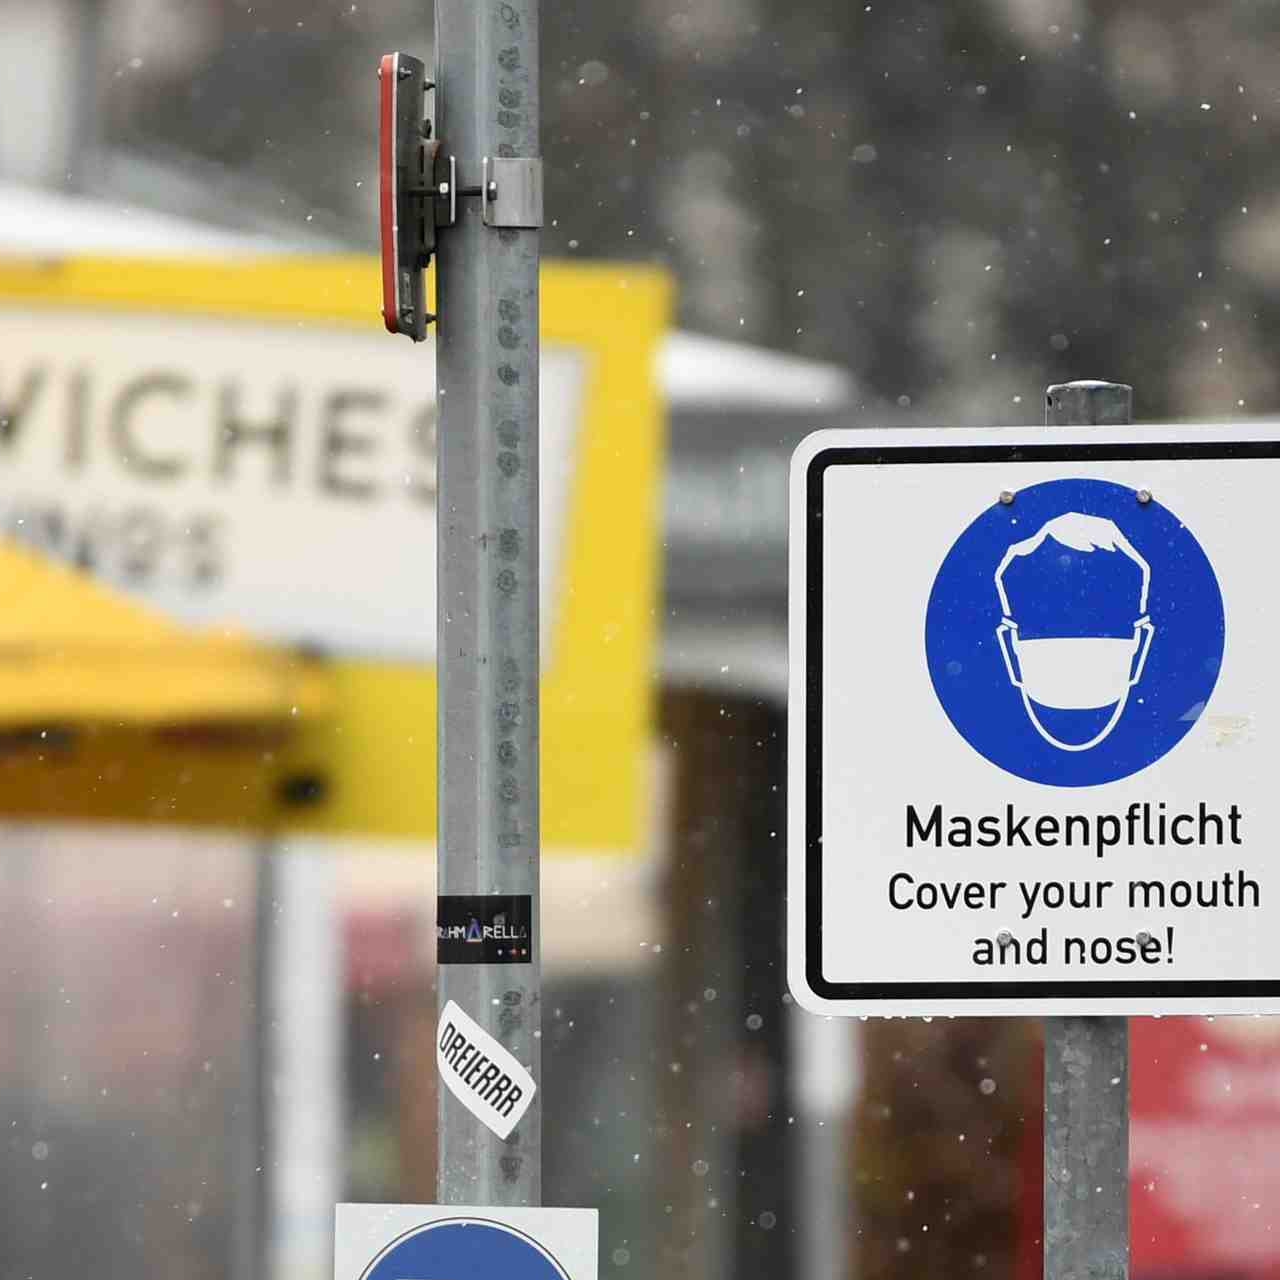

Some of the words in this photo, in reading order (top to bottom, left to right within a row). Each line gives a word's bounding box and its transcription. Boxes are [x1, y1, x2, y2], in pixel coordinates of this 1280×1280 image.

[905, 802, 1242, 857] Maskenpflicht
[888, 872, 1007, 910] Cover
[1018, 881, 1114, 919] your
[1128, 869, 1261, 908] mouth
[972, 927, 1048, 966] and
[1064, 926, 1175, 965] nose!
[439, 1021, 523, 1118] DREIERRR
